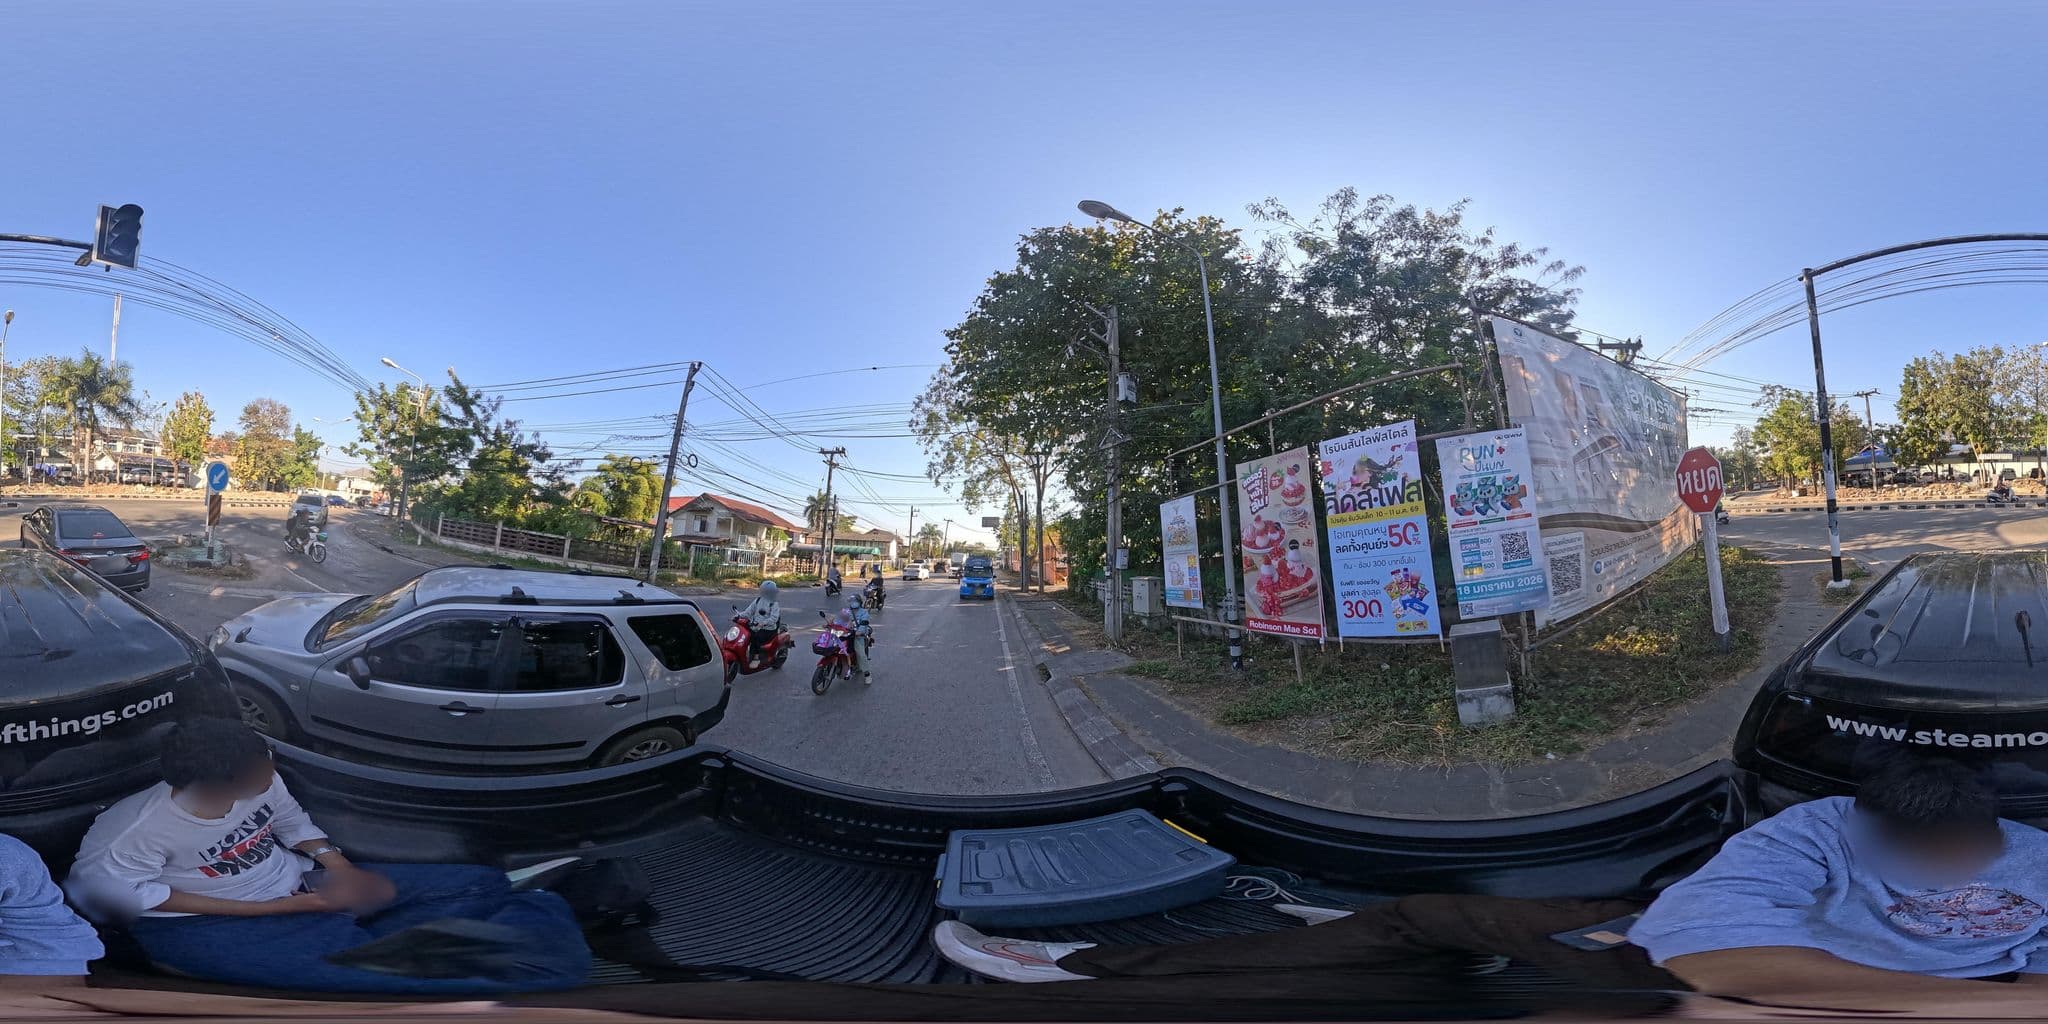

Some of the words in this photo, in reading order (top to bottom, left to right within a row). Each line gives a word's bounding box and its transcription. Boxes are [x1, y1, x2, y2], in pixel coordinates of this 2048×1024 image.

[1324, 426, 1408, 455] โรบินสันไลฟ์สไตล์
[1460, 444, 1494, 463] RUN
[1678, 466, 1721, 504] หยุด
[1333, 526, 1387, 540] ไอเทมคุณหนู
[1336, 538, 1388, 554] ลดทั้งศูนย์ฯ
[1373, 560, 1387, 568] 300
[1341, 589, 1360, 600] มูลค่า
[1457, 586, 1470, 595] 18
[1473, 581, 1514, 593] มกราคม
[1517, 575, 1543, 587] 2026
[1343, 599, 1383, 618] 300
[1249, 620, 1282, 631] Robinson
[1284, 625, 1300, 634] Mae
[1302, 626, 1317, 635] Sot
[0, 691, 174, 744] fthings.com
[1826, 714, 2048, 748] www.steamo
